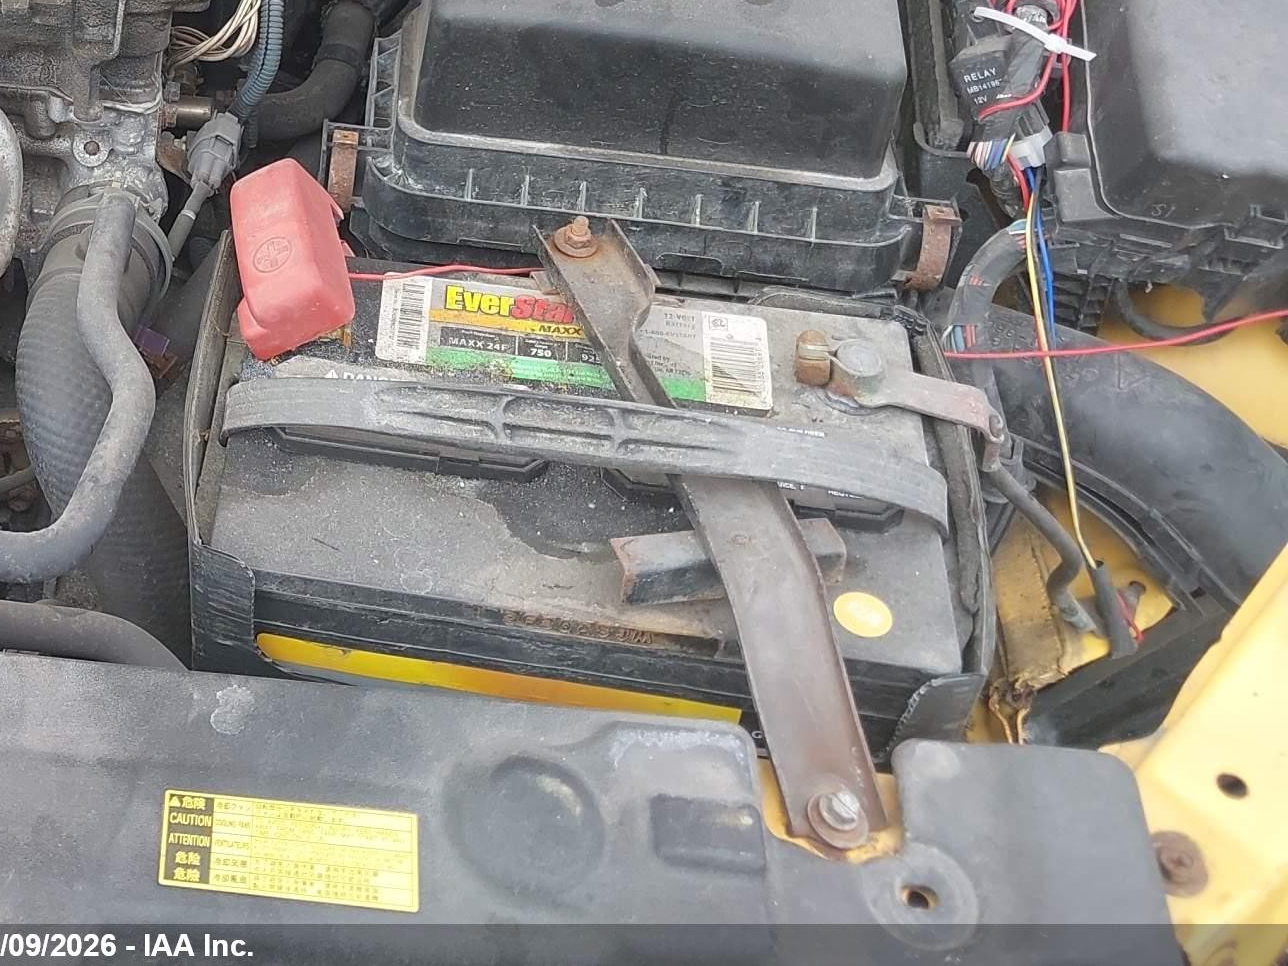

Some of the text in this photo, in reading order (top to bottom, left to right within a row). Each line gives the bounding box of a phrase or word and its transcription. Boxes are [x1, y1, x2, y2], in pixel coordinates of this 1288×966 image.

[963, 67, 996, 83] RELAY
[974, 95, 988, 106] 12V
[538, 325, 582, 336] MAXX
[448, 337, 510, 352] MAXX 24F
[529, 348, 553, 358] 750
[182, 796, 206, 810] 危険
[169, 812, 212, 827] CAUTION
[168, 833, 211, 848] ATTENTION
